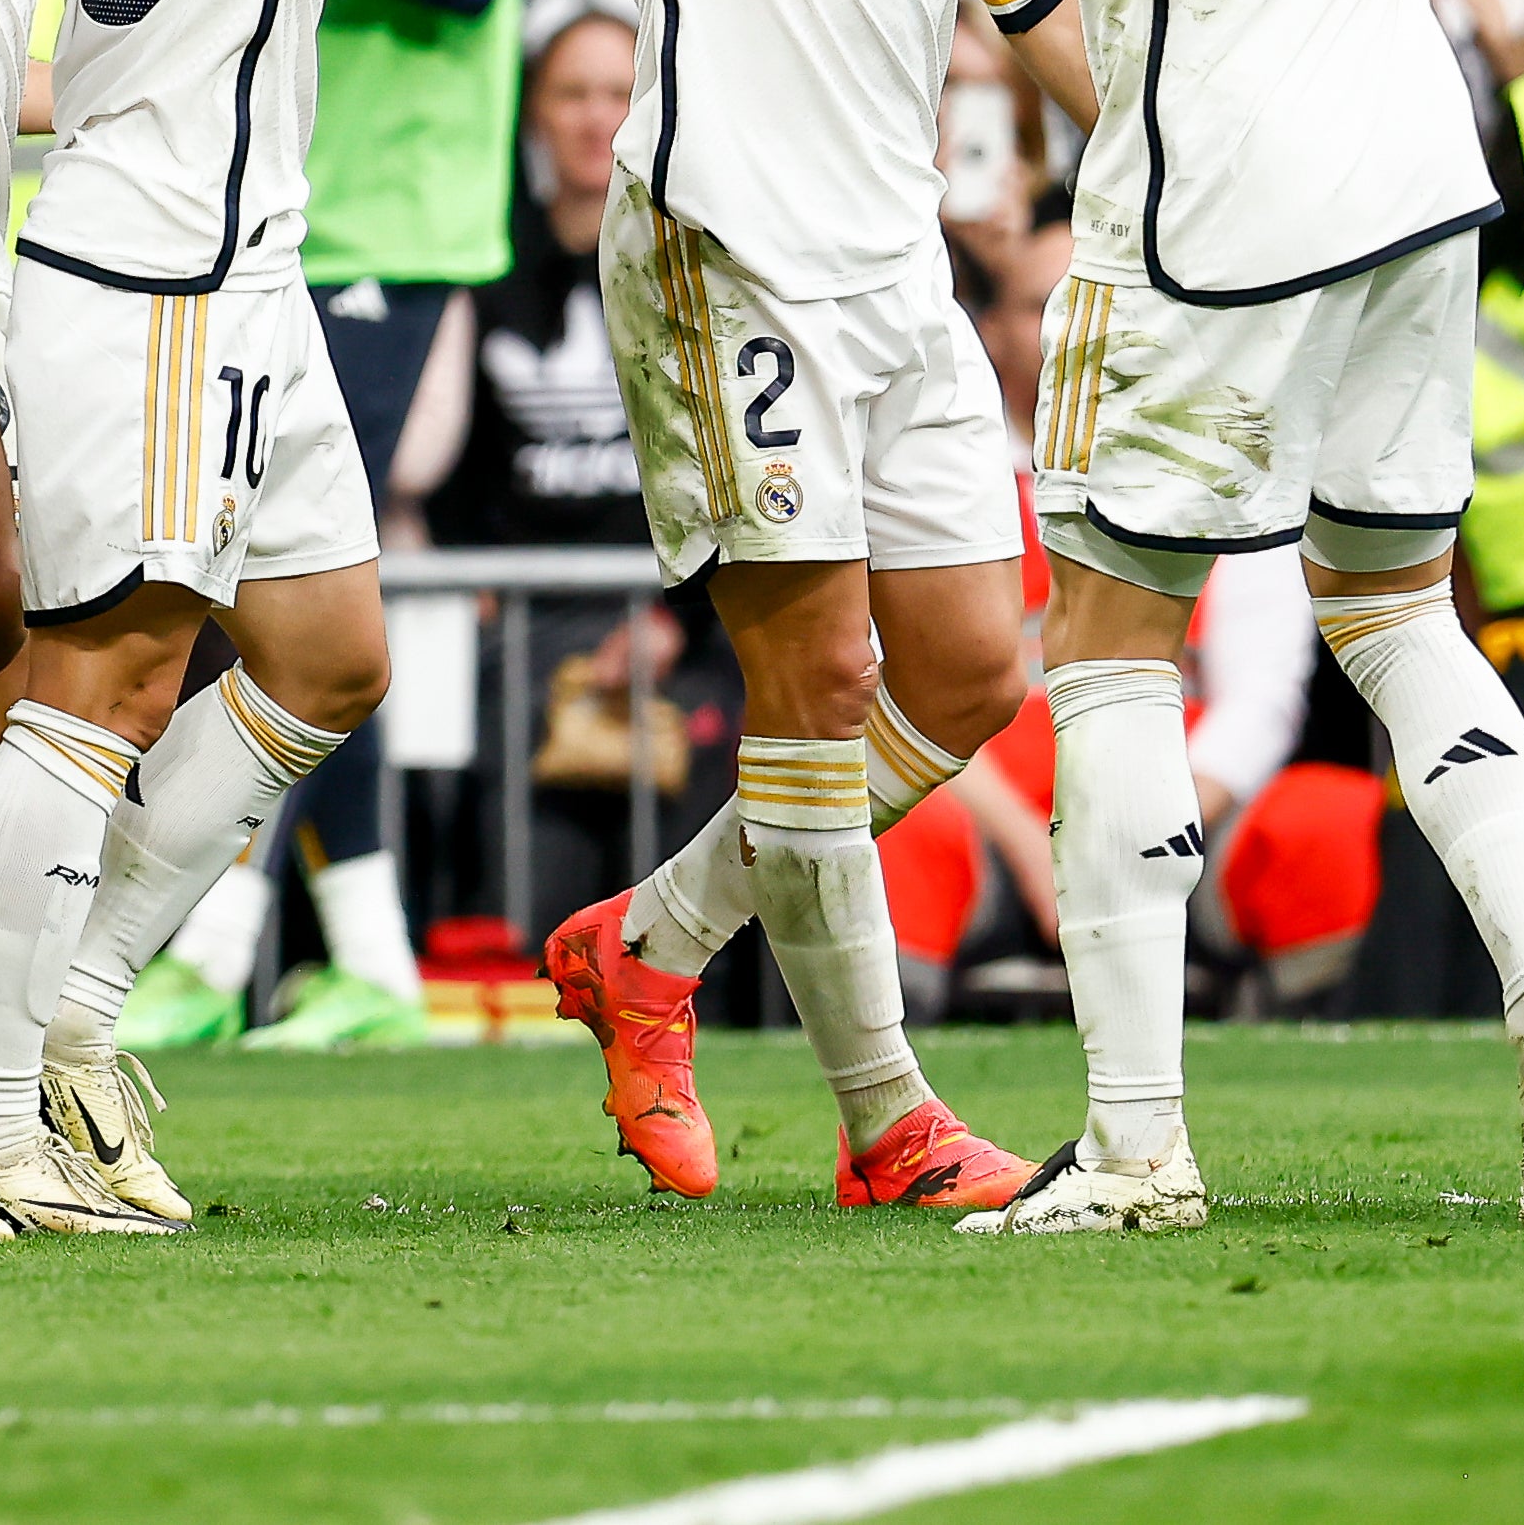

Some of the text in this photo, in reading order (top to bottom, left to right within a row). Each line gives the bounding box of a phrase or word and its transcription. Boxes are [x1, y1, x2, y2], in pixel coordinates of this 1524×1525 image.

[217, 365, 271, 490] 10
[737, 336, 803, 449] 2
[43, 862, 101, 890] RM
